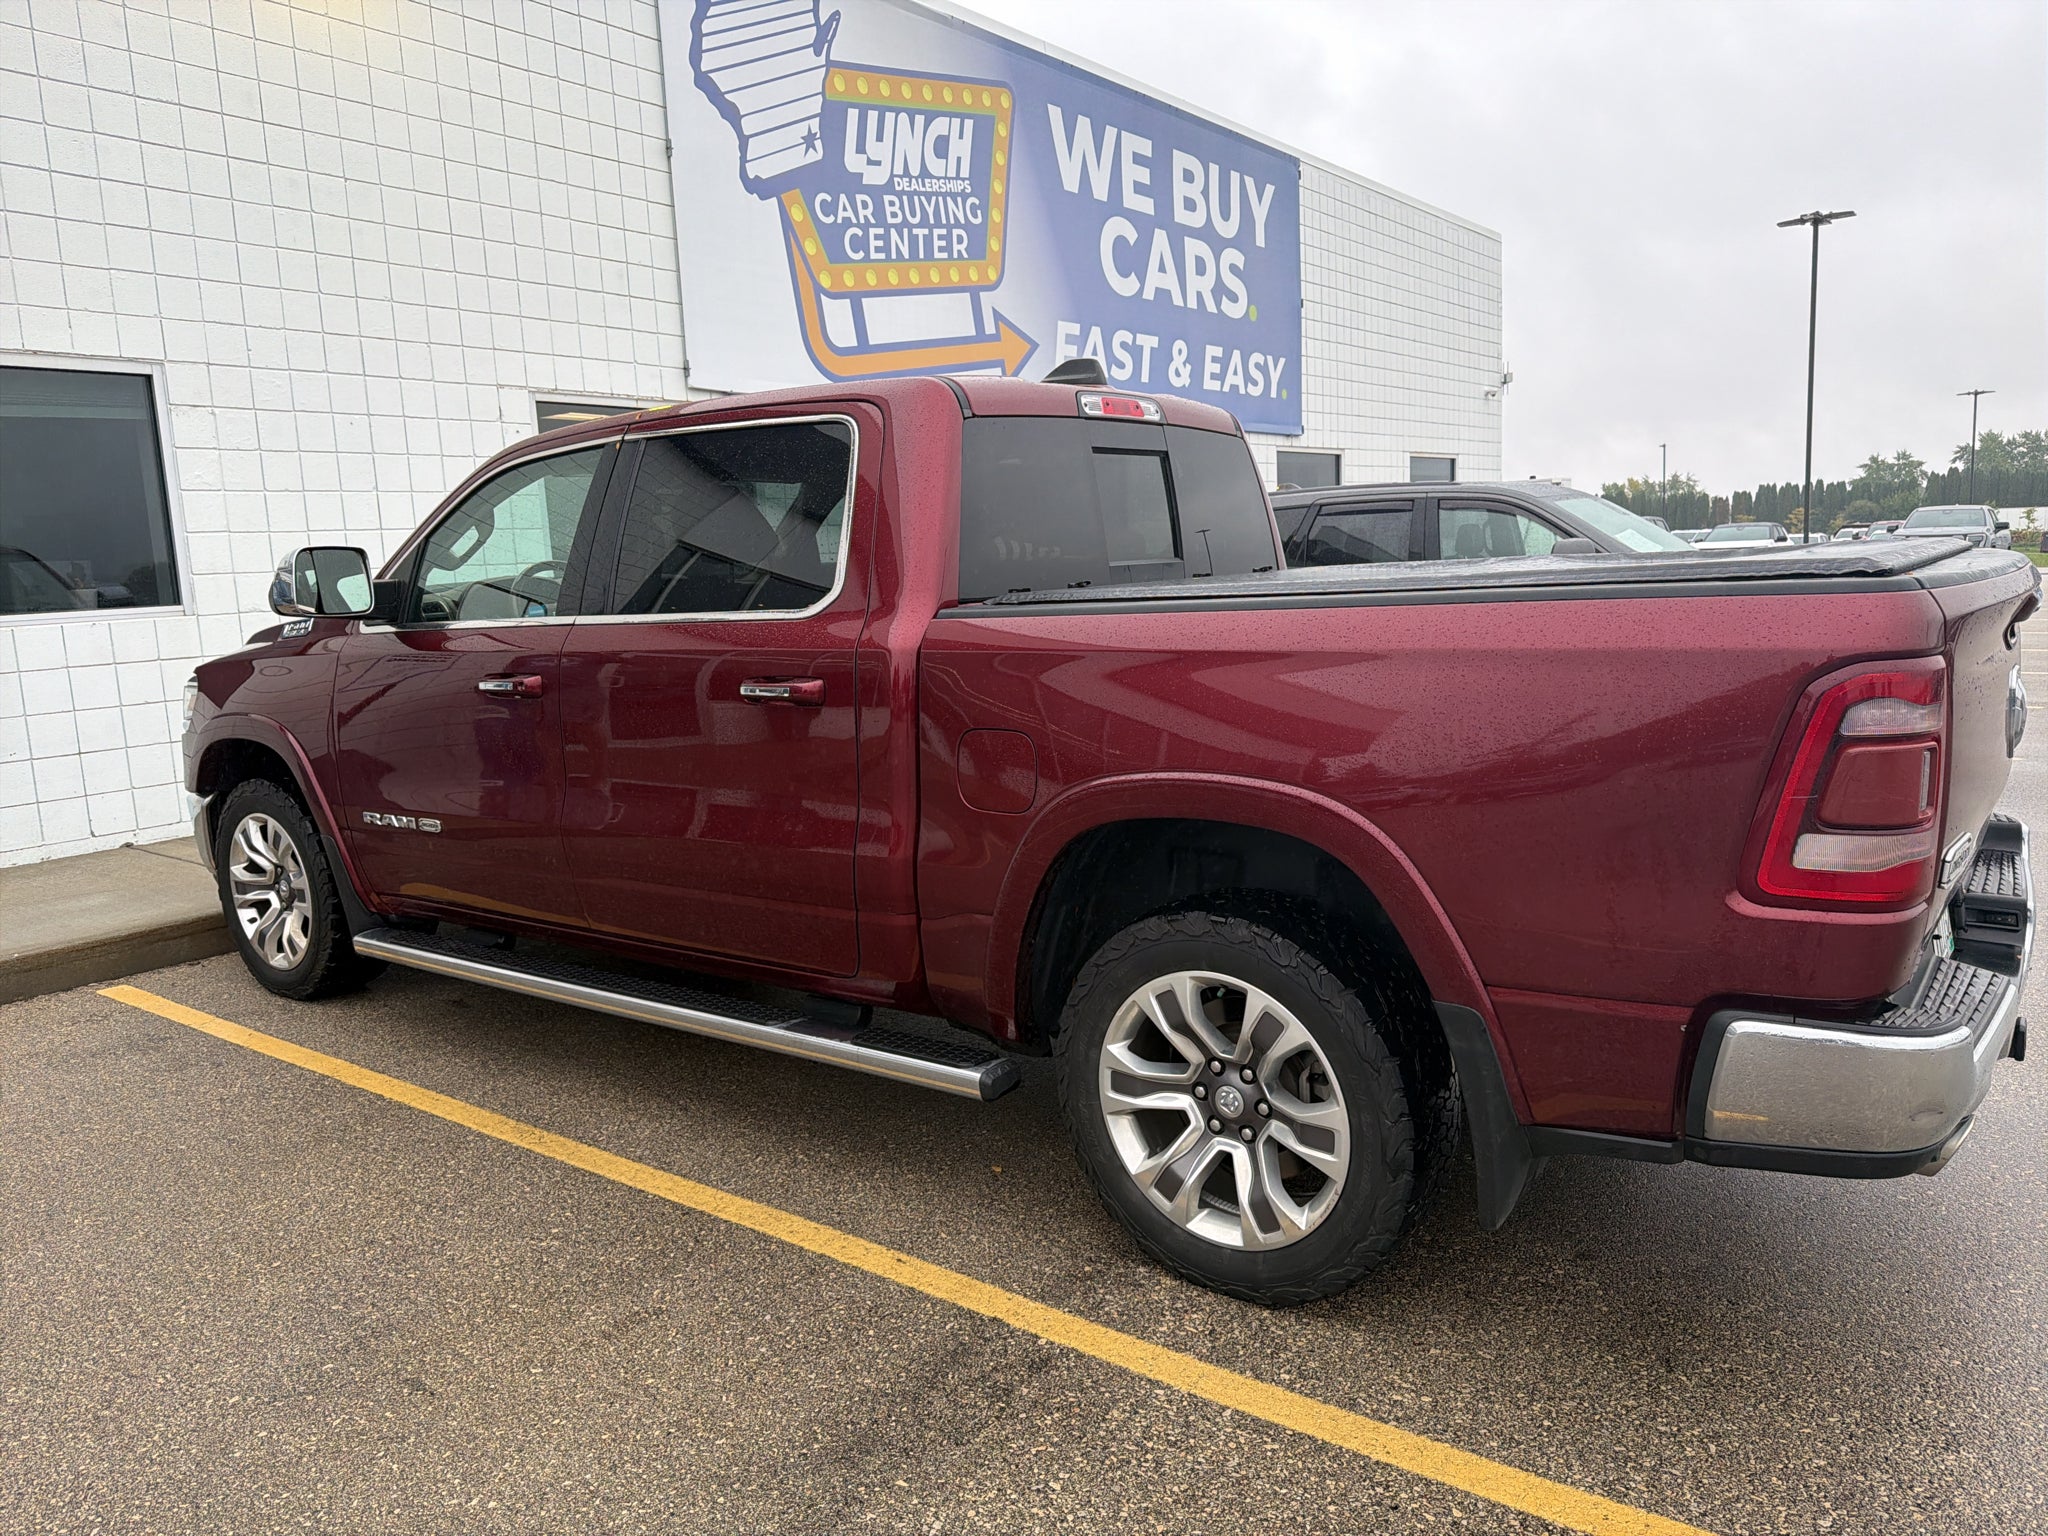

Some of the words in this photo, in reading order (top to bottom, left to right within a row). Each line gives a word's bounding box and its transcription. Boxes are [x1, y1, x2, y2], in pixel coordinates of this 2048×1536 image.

[844, 107, 974, 185] LYNCH
[893, 177, 972, 193] DEALERSHIPS
[1047, 103, 1155, 216] WE
[1172, 148, 1275, 248] BUY
[814, 193, 876, 224] CAR
[883, 194, 983, 225] BUYING
[844, 226, 969, 261] CENTER
[1100, 216, 1258, 322] CARS.
[1055, 320, 1159, 383] FAST
[1168, 339, 1192, 388] &
[1203, 344, 1288, 400] EASY.
[363, 811, 417, 830] RAM
